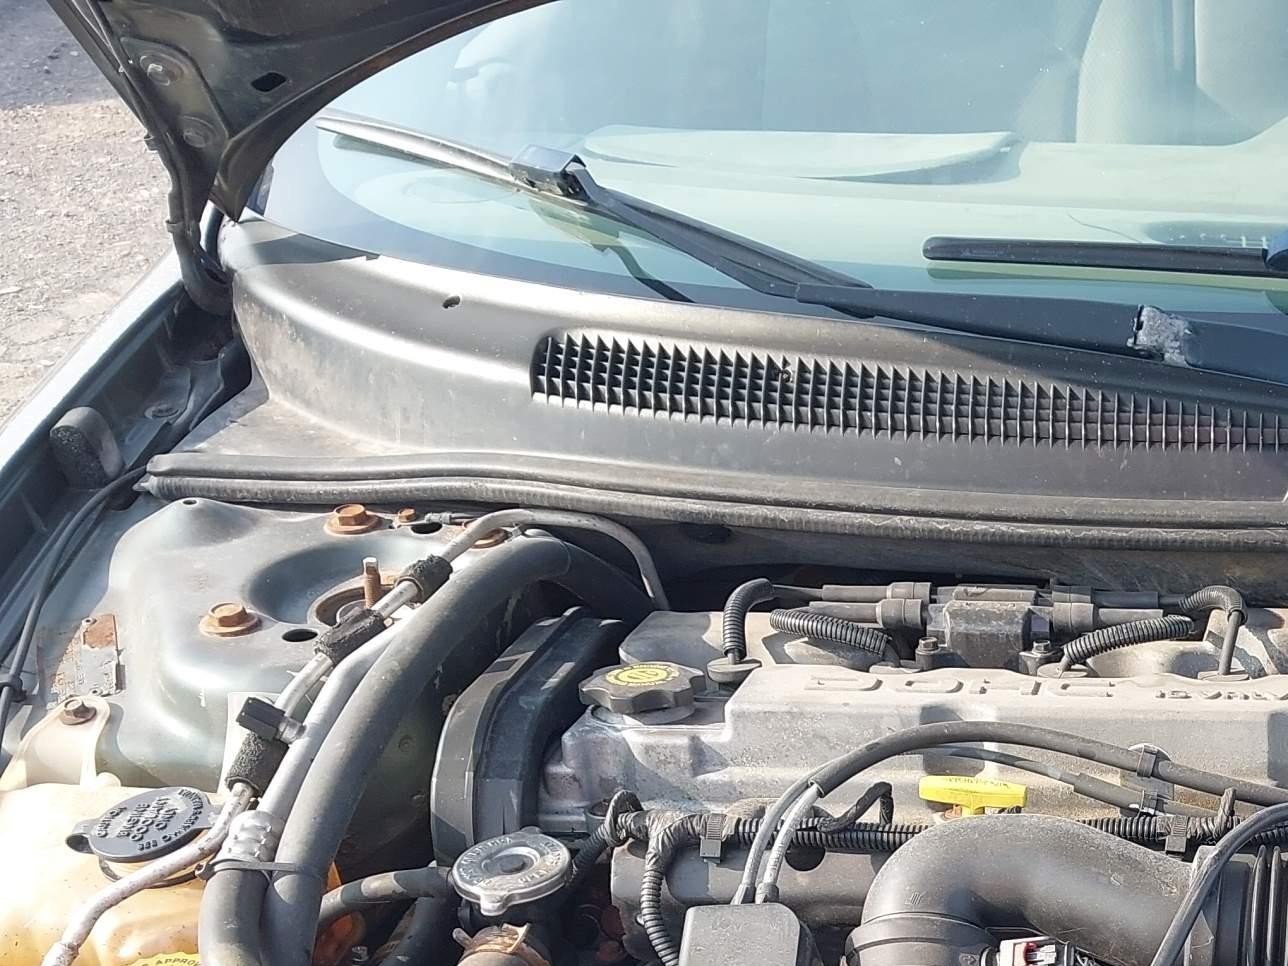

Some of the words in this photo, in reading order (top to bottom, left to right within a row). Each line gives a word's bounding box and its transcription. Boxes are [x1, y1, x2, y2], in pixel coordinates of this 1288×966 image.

[804, 676, 1115, 698] DOHC
[116, 802, 151, 838] ENGINE
[130, 797, 170, 841] COOLANT
[155, 807, 178, 831] ONLY
